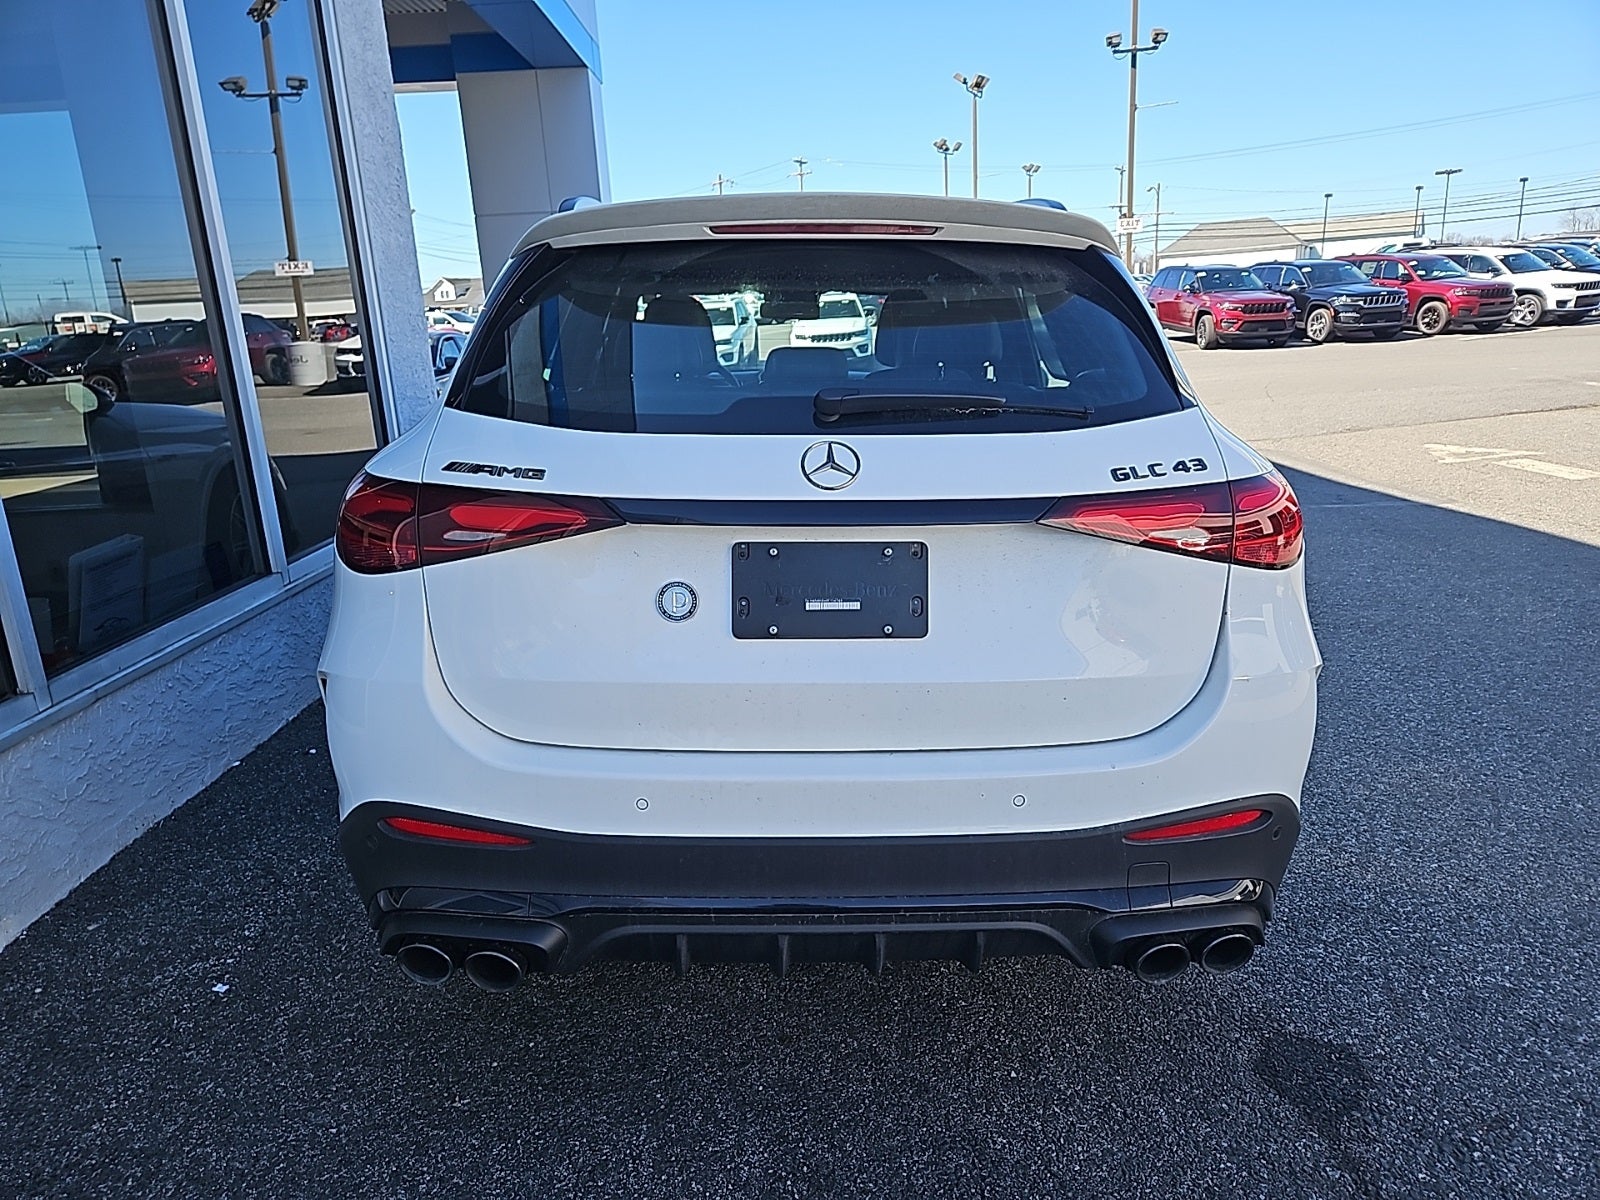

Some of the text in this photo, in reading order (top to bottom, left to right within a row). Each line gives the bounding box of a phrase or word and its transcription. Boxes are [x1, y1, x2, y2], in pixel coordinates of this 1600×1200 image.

[1120, 219, 1141, 227] EXIT
[1110, 457, 1209, 482] GLC 43
[762, 580, 897, 598] Mercedes-Benz
